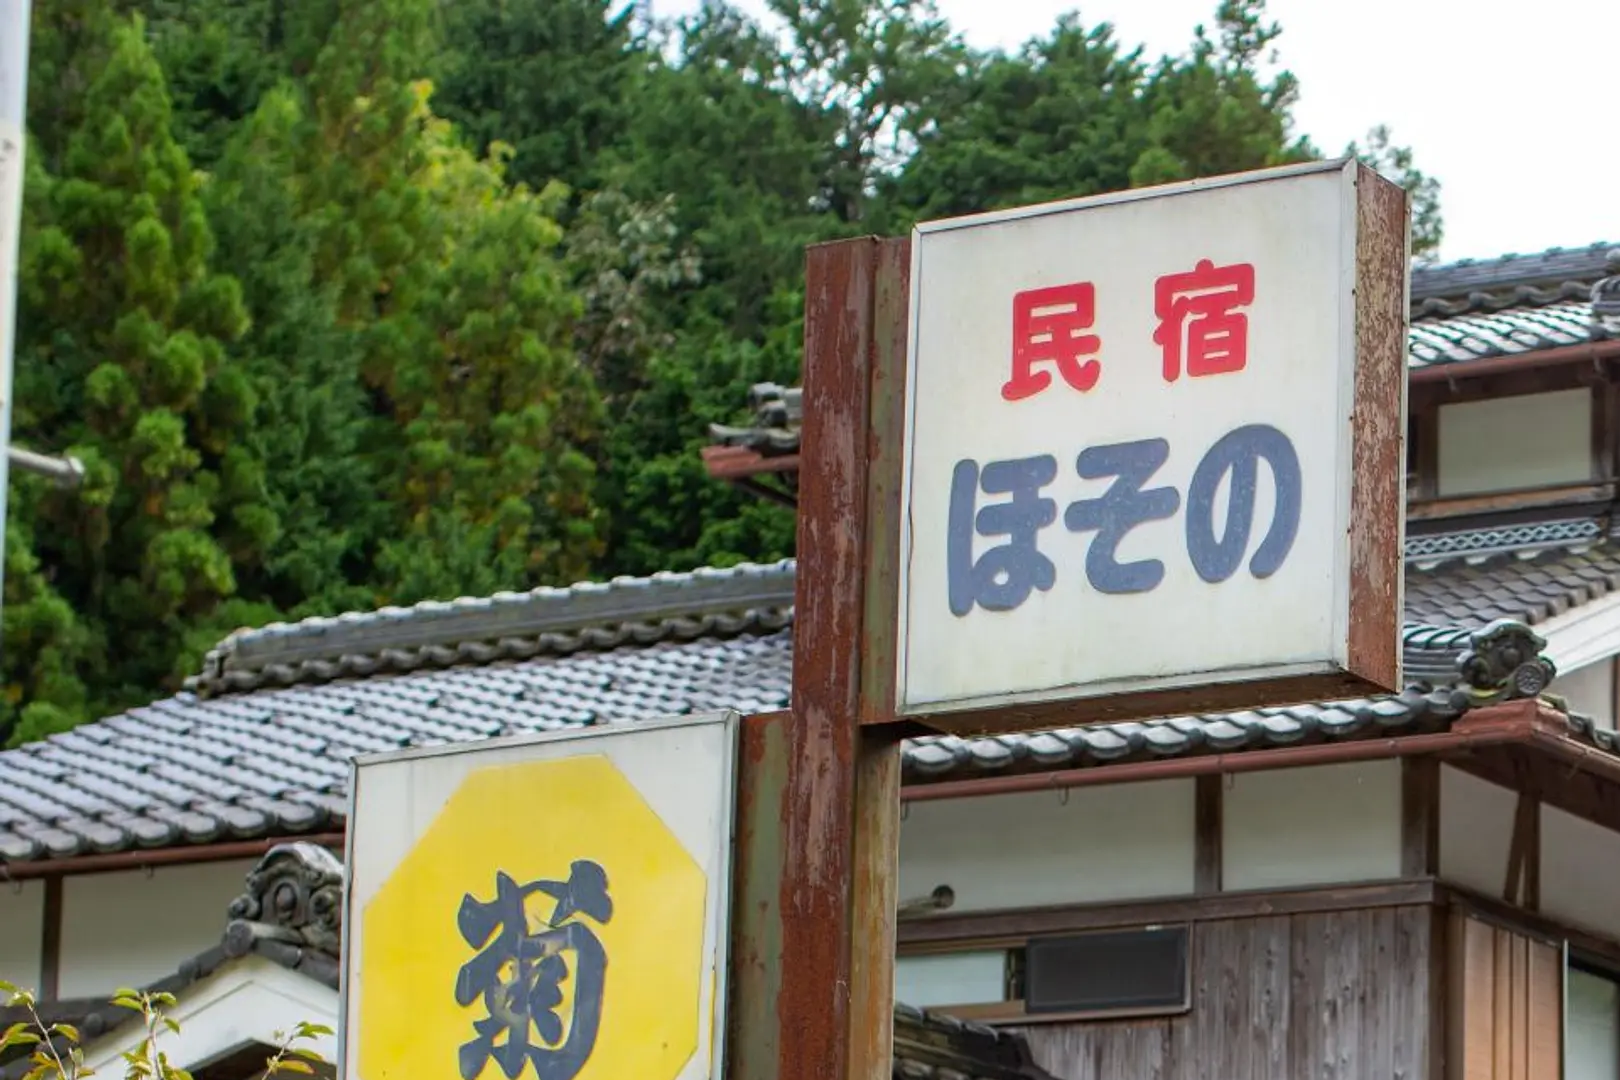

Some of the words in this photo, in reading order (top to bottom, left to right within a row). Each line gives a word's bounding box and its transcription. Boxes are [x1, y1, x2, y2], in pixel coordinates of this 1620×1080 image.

[1001, 259, 1255, 401] 民宿
[947, 424, 1302, 617] ほその
